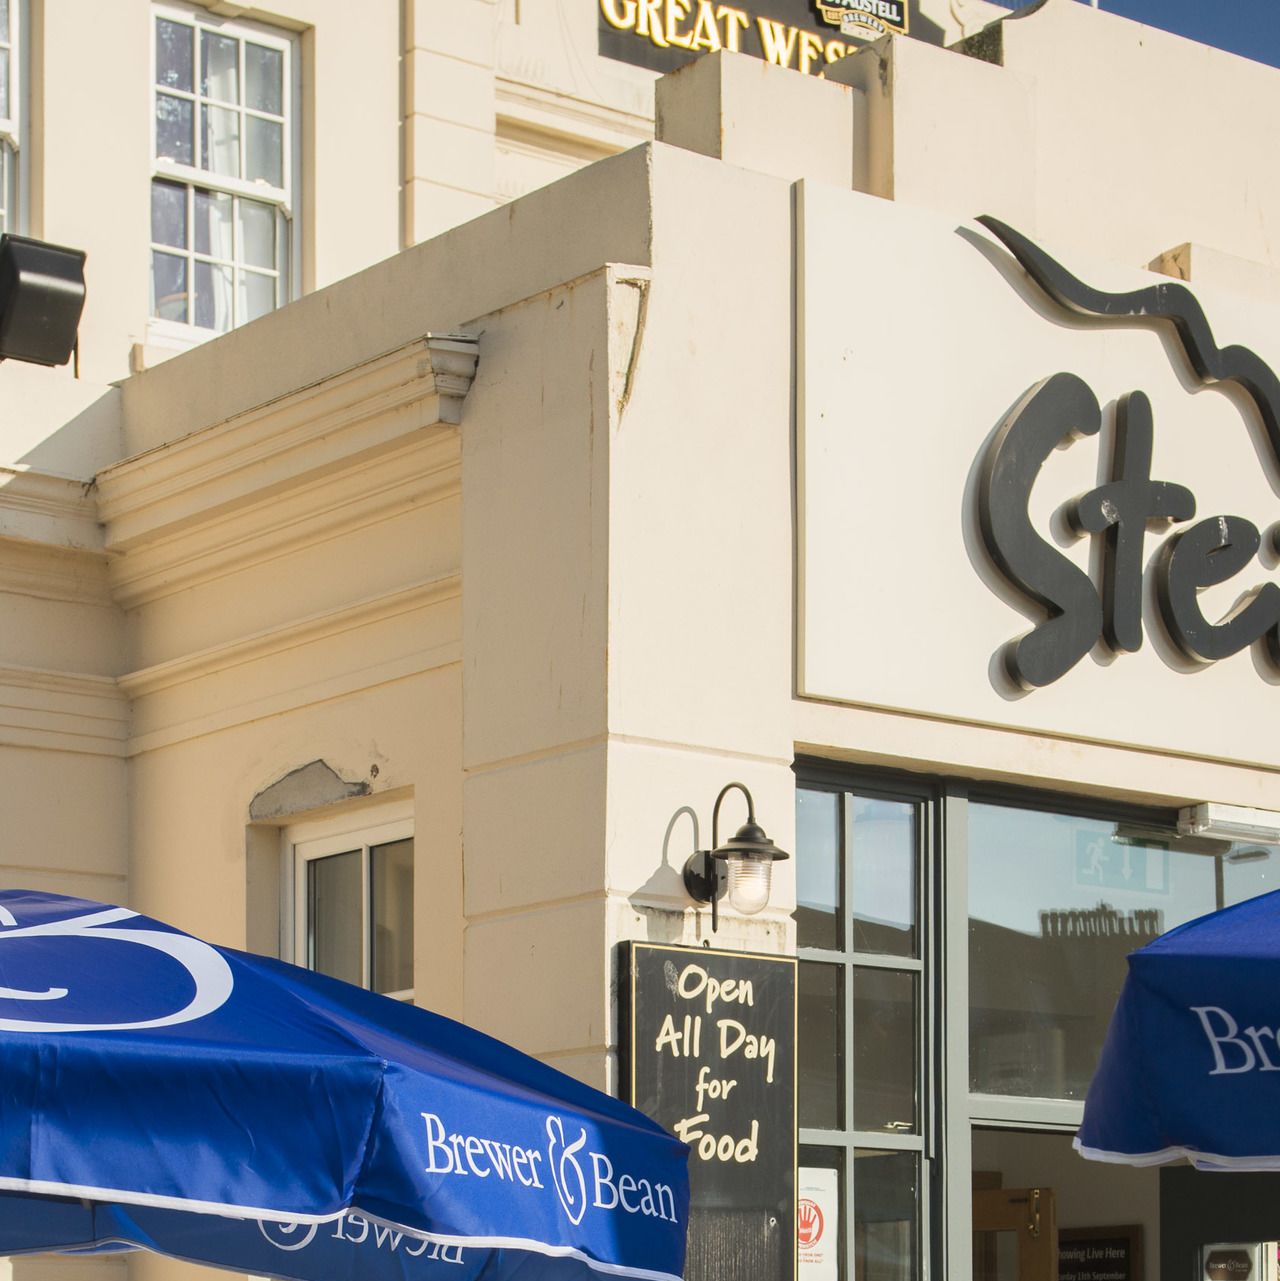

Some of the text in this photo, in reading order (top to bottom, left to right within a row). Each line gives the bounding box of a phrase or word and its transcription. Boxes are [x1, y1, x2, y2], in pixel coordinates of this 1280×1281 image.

[599, 0, 749, 53] GREAT
[678, 964, 754, 1014] Open
[655, 1014, 776, 1084] All Day
[695, 1066, 738, 1112] for
[673, 1114, 759, 1163] Food
[421, 1112, 679, 1225] Brewer & Bean
[1105, 1247, 1126, 1259] Here
